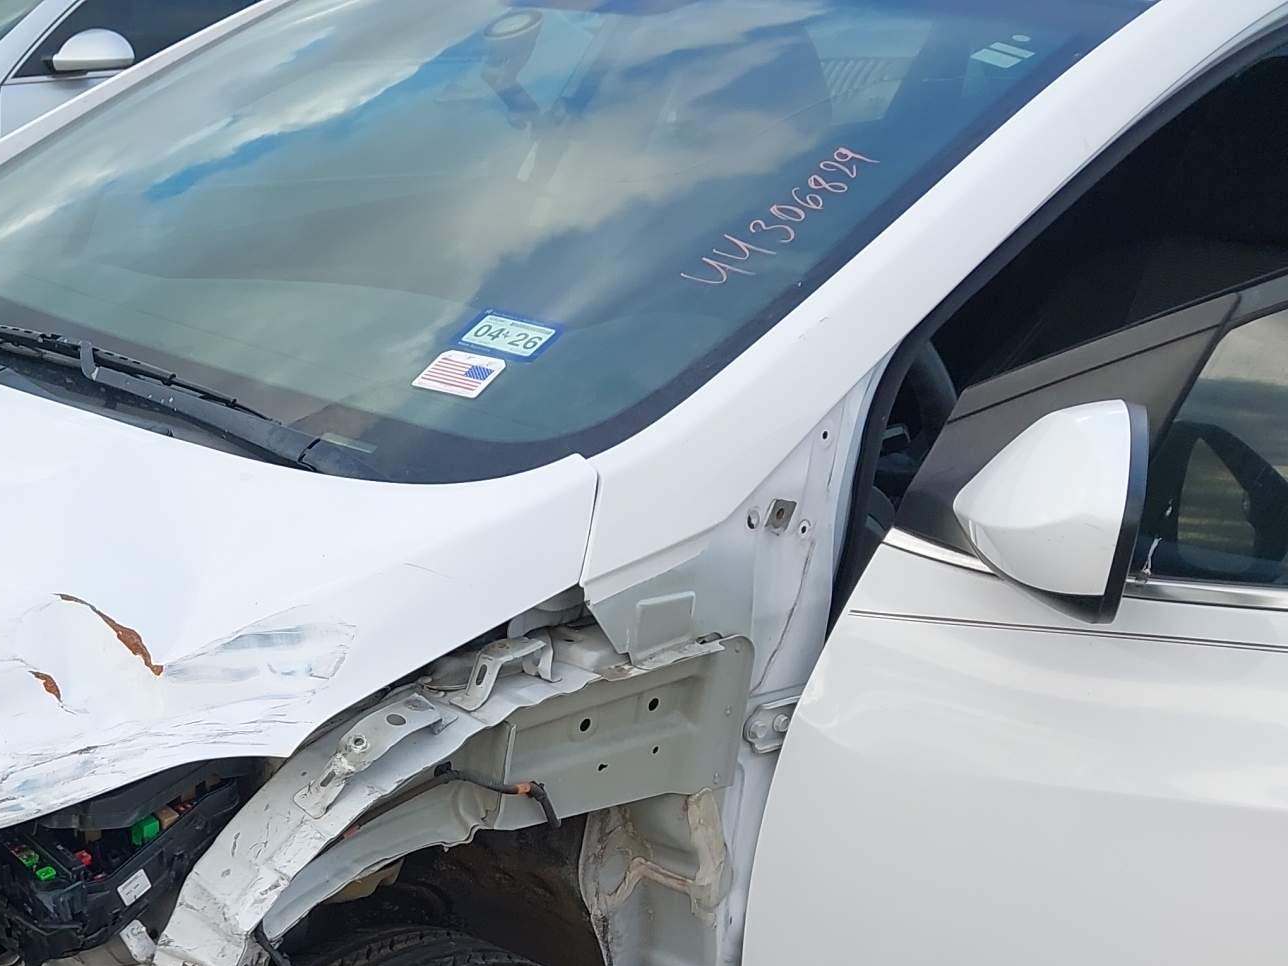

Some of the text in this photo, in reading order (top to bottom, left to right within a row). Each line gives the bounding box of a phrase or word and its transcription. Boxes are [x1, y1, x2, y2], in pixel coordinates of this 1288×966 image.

[680, 146, 881, 285] 44306829
[473, 323, 502, 341] 04
[507, 332, 543, 350] 26
